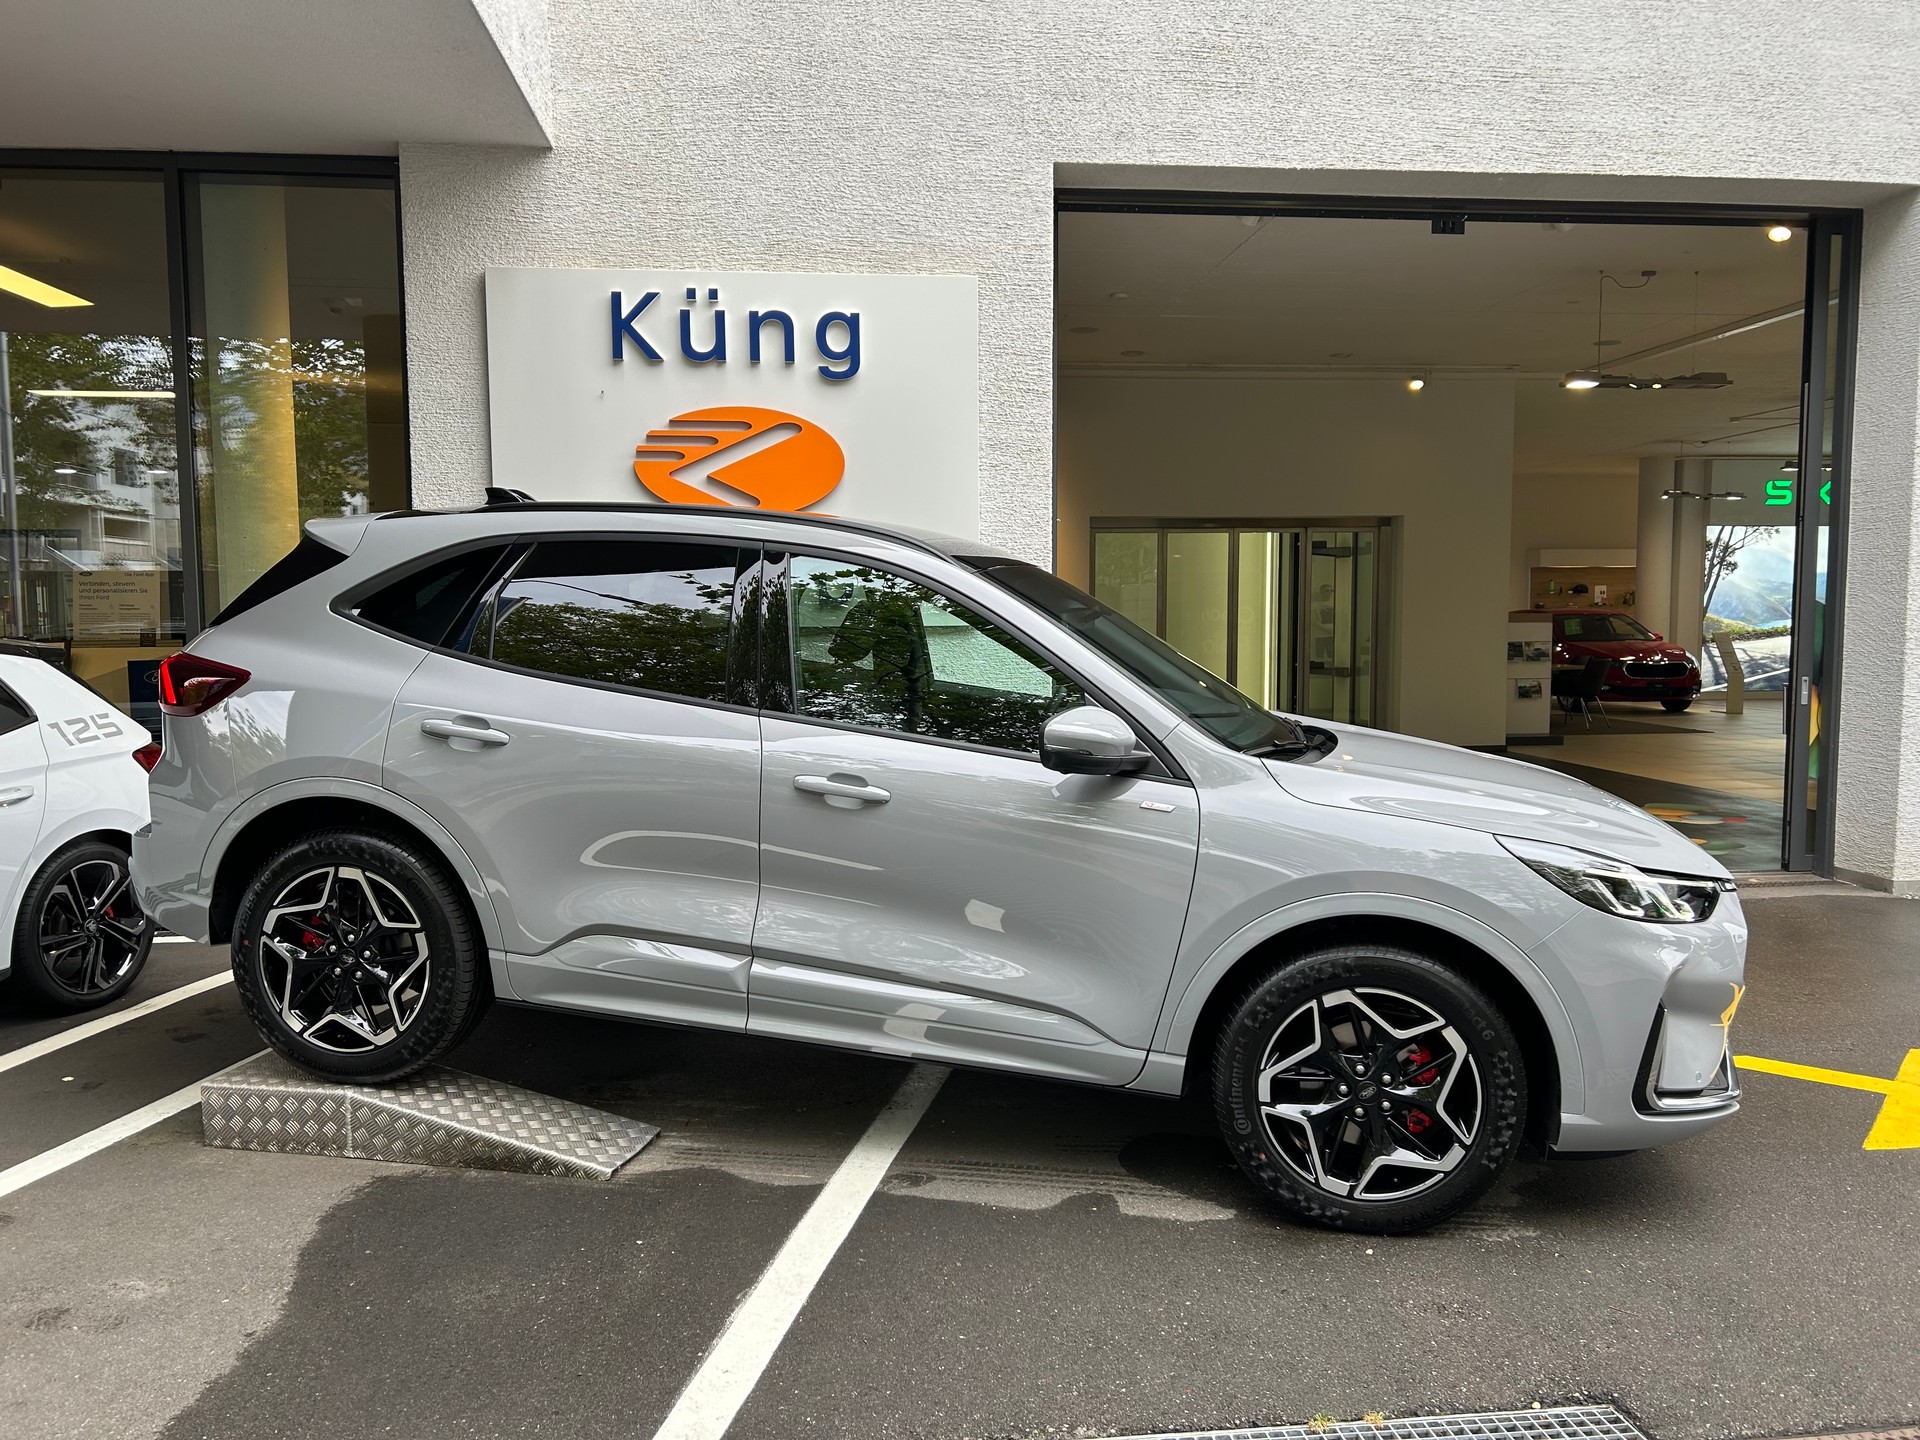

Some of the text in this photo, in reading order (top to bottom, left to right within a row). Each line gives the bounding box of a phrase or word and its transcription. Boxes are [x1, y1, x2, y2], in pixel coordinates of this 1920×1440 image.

[610, 287, 861, 380] Küng
[47, 712, 123, 746] 125
[1229, 1046, 1252, 1134] Continental
